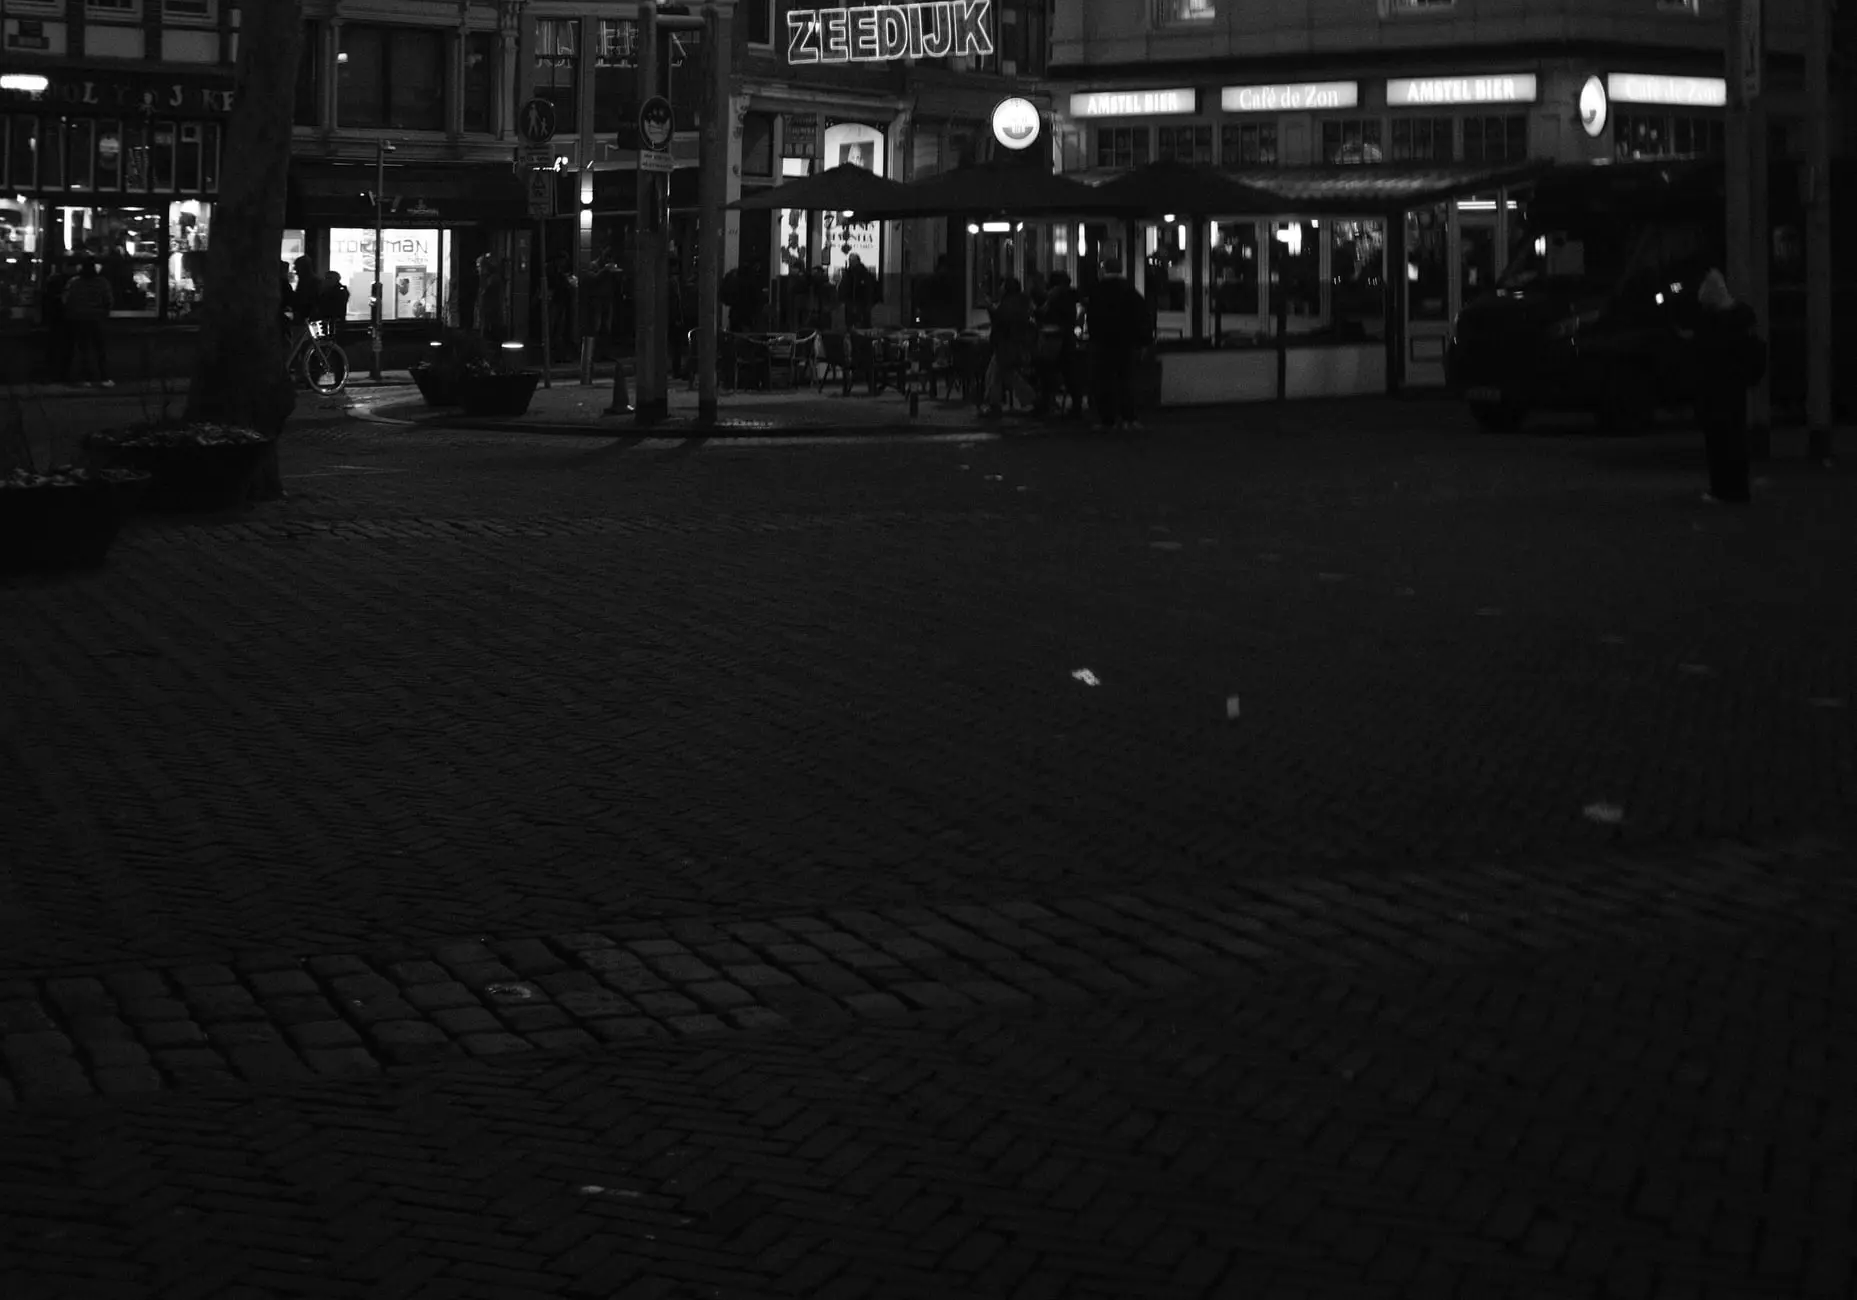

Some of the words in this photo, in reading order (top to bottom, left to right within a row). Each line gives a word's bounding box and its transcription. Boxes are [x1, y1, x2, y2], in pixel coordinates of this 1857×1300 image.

[1239, 85, 1277, 110] Café
[1280, 86, 1301, 109] de
[1304, 85, 1339, 108] Zon
[1407, 79, 1472, 102] AMSTEL
[1475, 77, 1515, 101] BIER
[1087, 95, 1142, 115] AMSTEL
[1144, 92, 1178, 113] BIER
